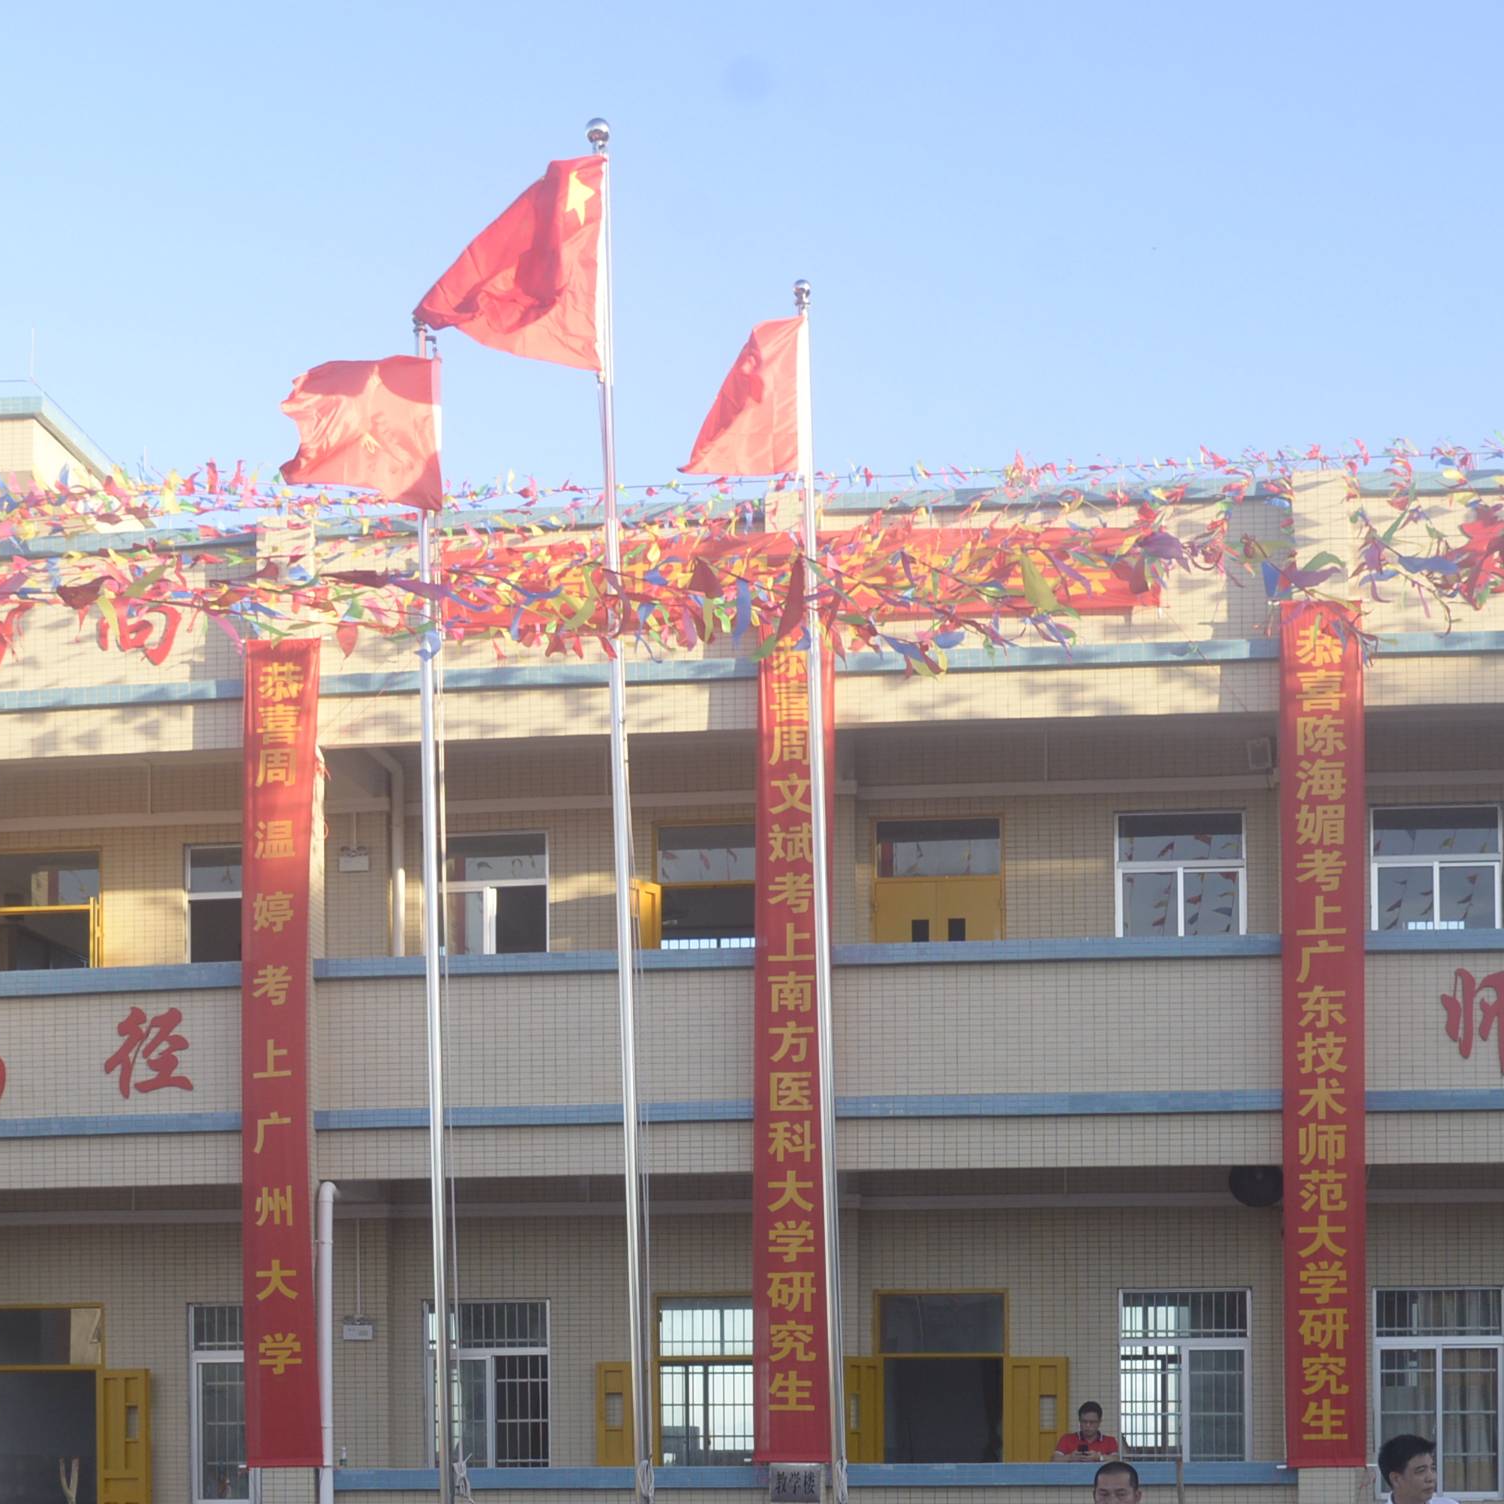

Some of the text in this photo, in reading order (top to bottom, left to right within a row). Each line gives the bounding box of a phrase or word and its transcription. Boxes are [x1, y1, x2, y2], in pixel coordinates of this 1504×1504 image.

[253, 662, 303, 1375] 恭喜周温婷考上广州大学
[1295, 624, 1349, 1441] 恭喜陈海媚考上广东技术师范大学研究生
